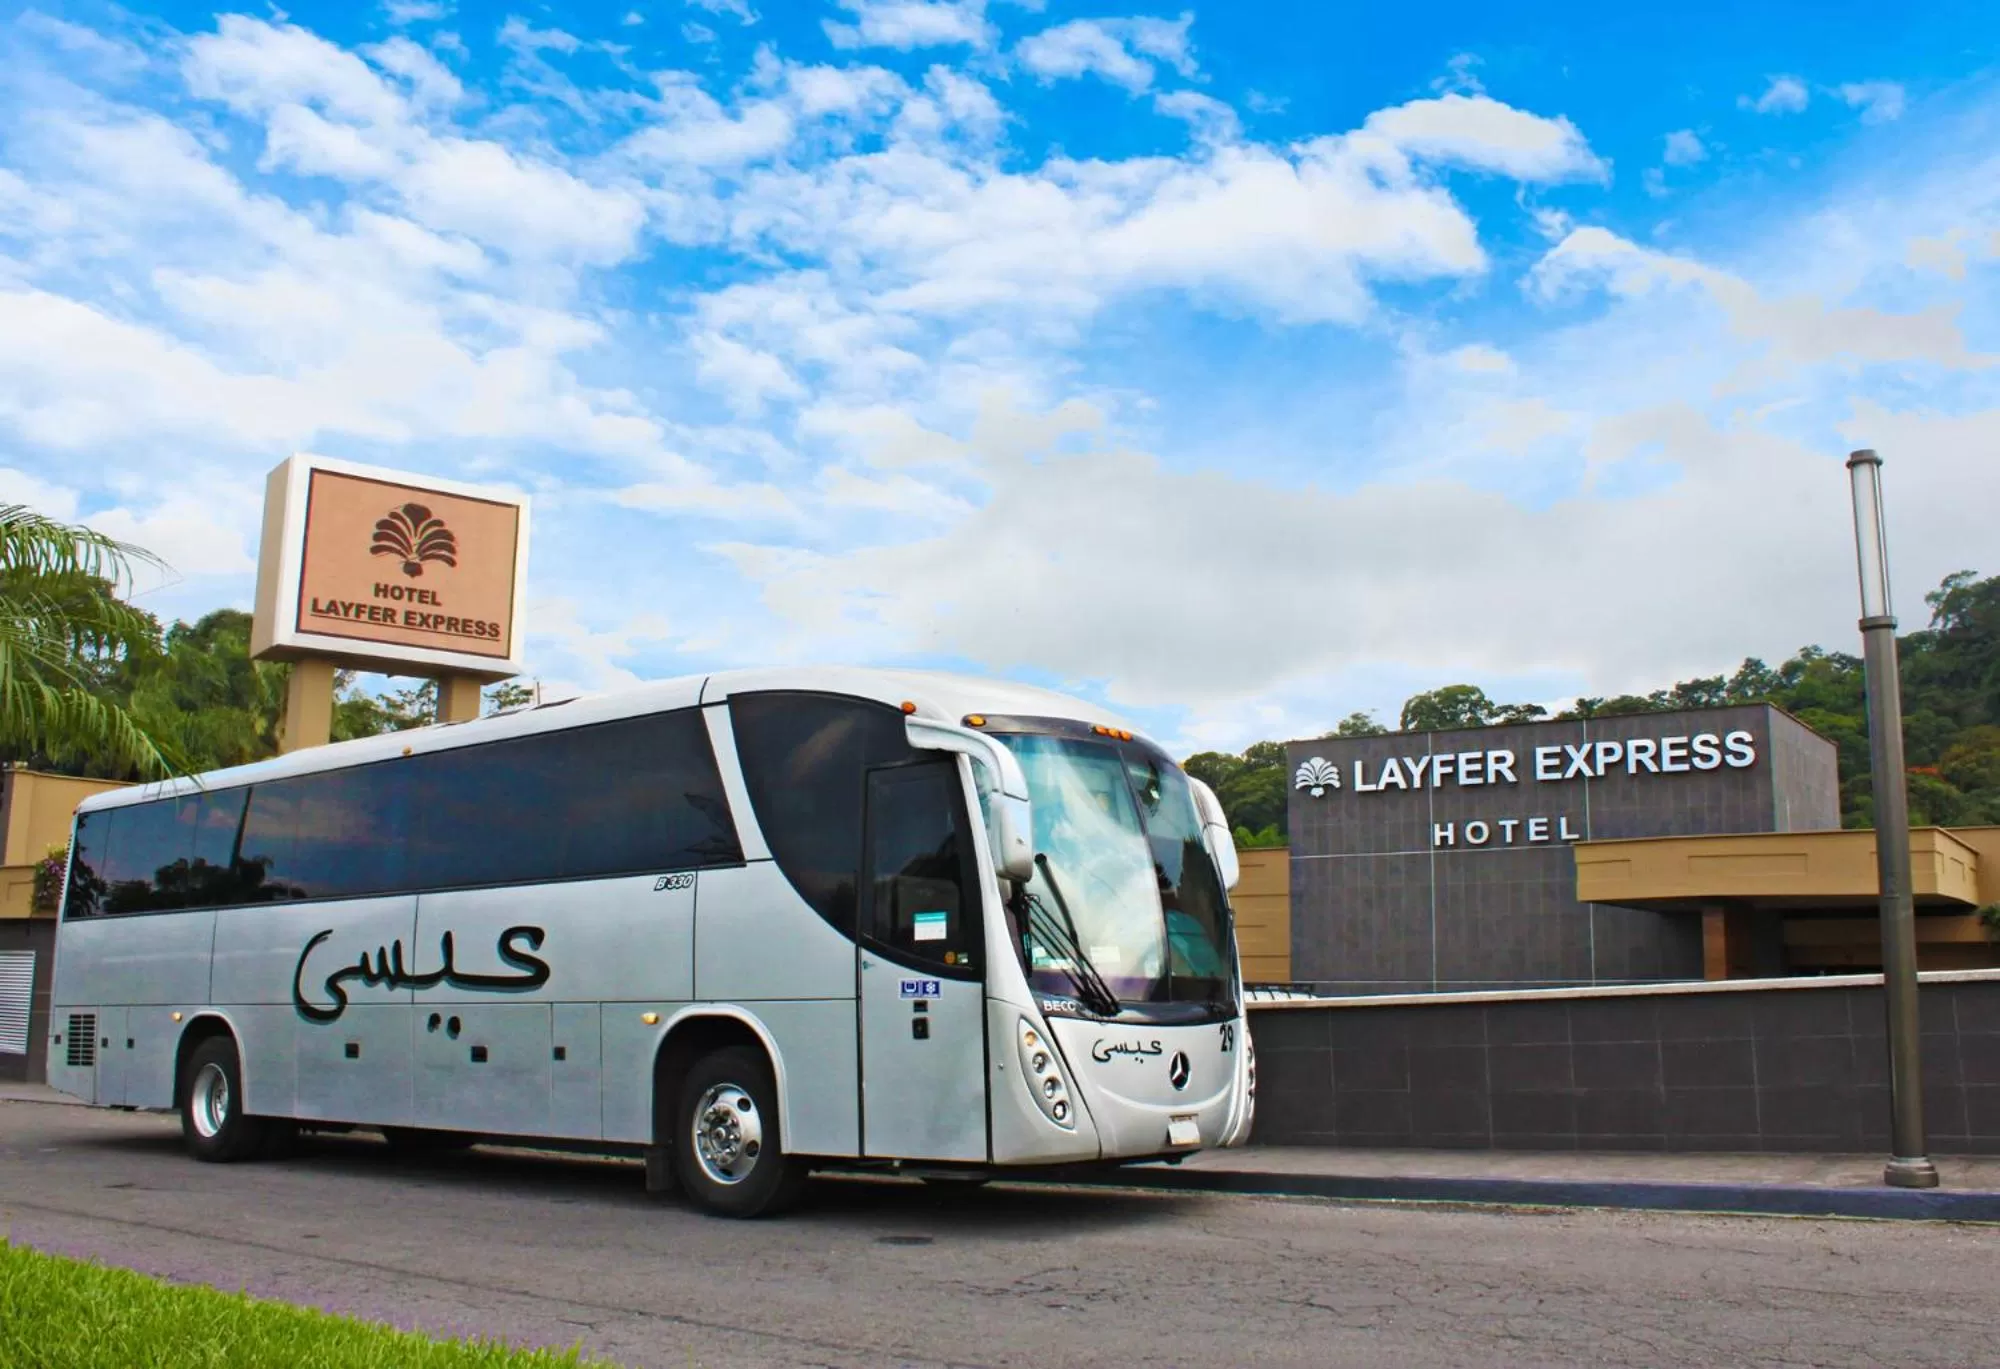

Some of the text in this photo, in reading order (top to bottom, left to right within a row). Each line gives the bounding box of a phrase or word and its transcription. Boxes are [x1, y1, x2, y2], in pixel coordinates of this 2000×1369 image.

[374, 583, 442, 606] HOTEL
[311, 597, 501, 638] LAYFER EXPRESS
[1353, 730, 1756, 793] LAYFER EXPRESS
[1433, 816, 1580, 846] HOTEL
[1043, 1000, 1077, 1012] BECC
[1219, 1024, 1234, 1052] 29
